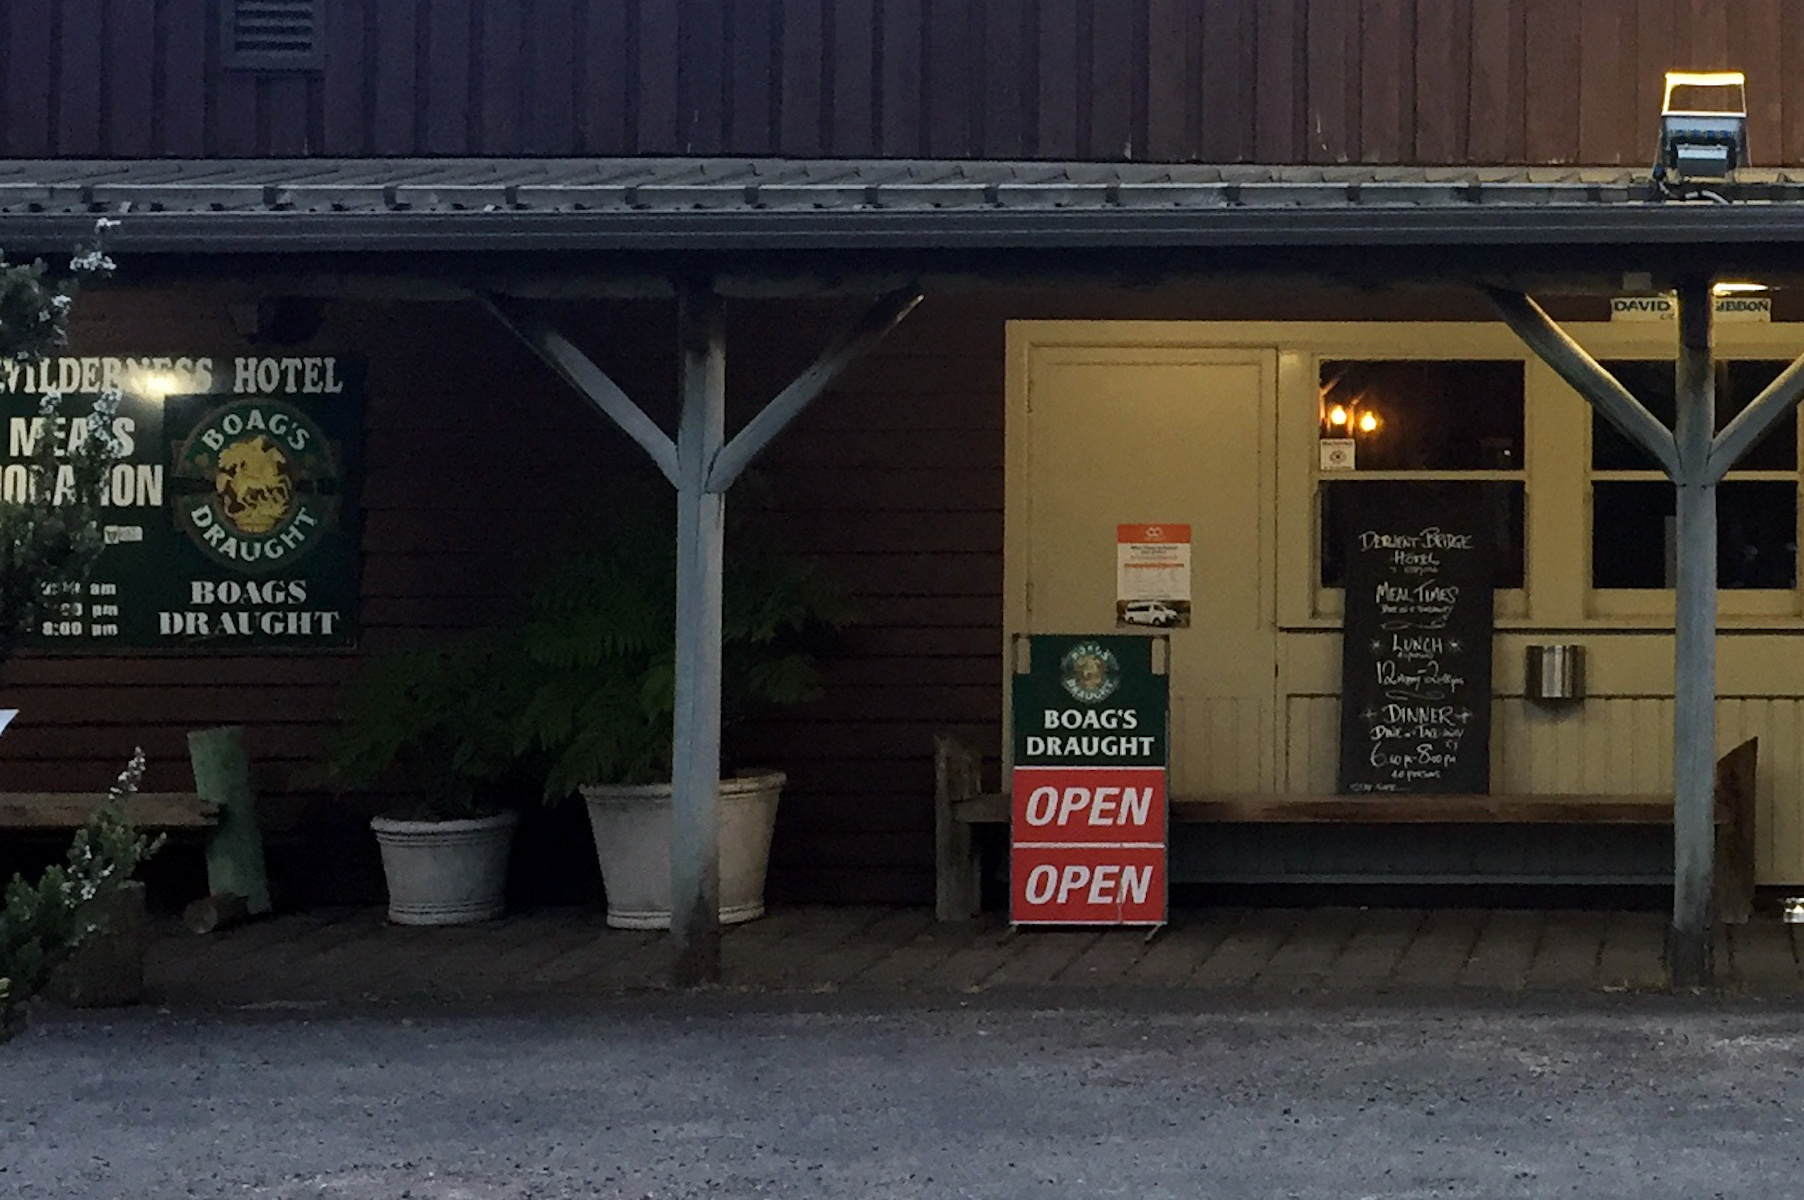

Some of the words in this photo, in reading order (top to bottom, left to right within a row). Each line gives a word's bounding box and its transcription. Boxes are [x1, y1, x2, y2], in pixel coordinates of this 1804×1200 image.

[1614, 300, 1671, 312] DAVID
[233, 356, 343, 394] HOTEL
[9, 416, 136, 458] MEAS
[202, 409, 311, 451] BOAG'S
[190, 504, 318, 562] DRAUGHT
[89, 582, 117, 596] am
[190, 579, 308, 605] BOAGS
[91, 603, 119, 618] pm
[91, 623, 119, 637] pm
[158, 611, 340, 635] DRAUGHT
[1391, 633, 1443, 655] LUNCH
[1044, 708, 1138, 730] BOAG'S
[1381, 703, 1456, 727] DINNER
[1026, 736, 1156, 756] DRAUGHT
[1024, 785, 1153, 827] OPEN
[1024, 864, 1153, 905] OPEN
